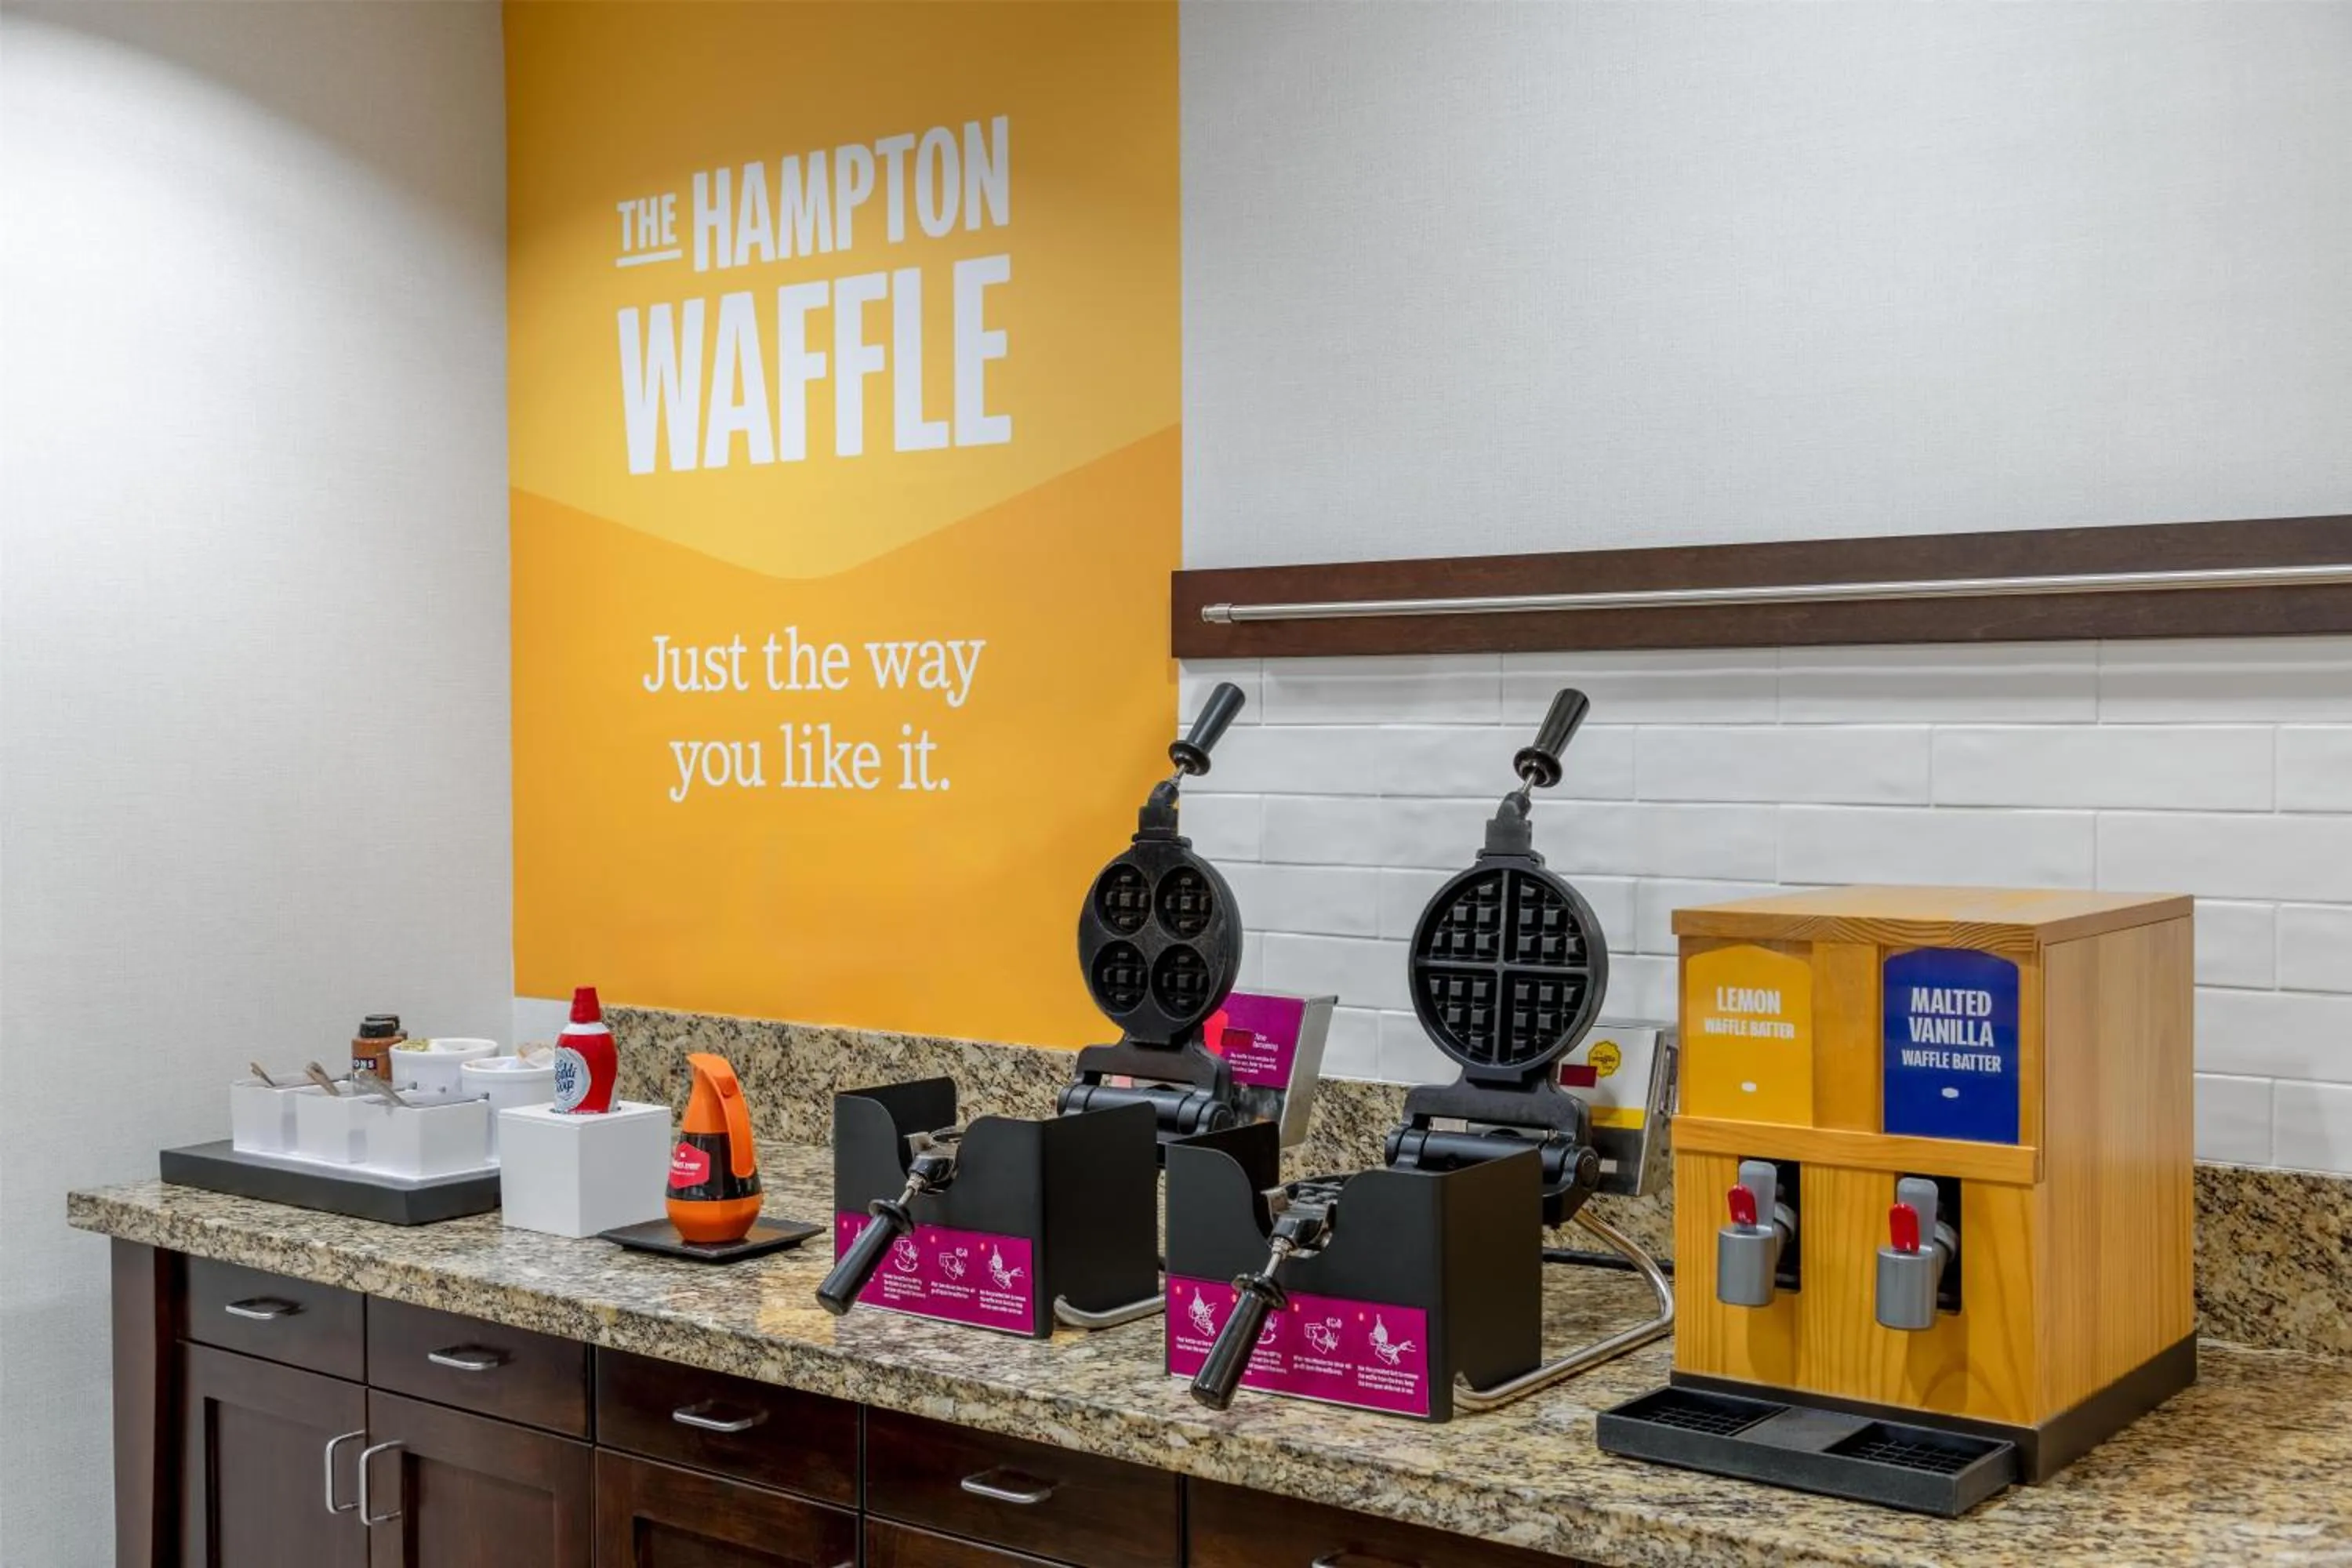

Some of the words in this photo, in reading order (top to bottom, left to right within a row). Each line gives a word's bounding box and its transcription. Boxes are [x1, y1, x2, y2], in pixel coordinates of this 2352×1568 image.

[617, 193, 677, 252] THE
[692, 115, 1010, 273] HAMPTON
[617, 253, 1012, 476] WAFFLE
[642, 633, 750, 692] Just
[762, 626, 851, 691] the
[864, 639, 987, 707] way
[669, 740, 767, 804] you
[779, 723, 882, 790] like
[898, 723, 950, 791] it.
[1716, 985, 1781, 1015] LEMON
[1910, 986, 1993, 1017] MALTED
[1704, 1017, 1748, 1036] WAFFLE
[1750, 1020, 1795, 1040] BATTER
[1907, 1016, 1994, 1048] VANILLA
[1901, 1049, 1950, 1069] WAFFLE
[1951, 1052, 2002, 1073] BATTER
